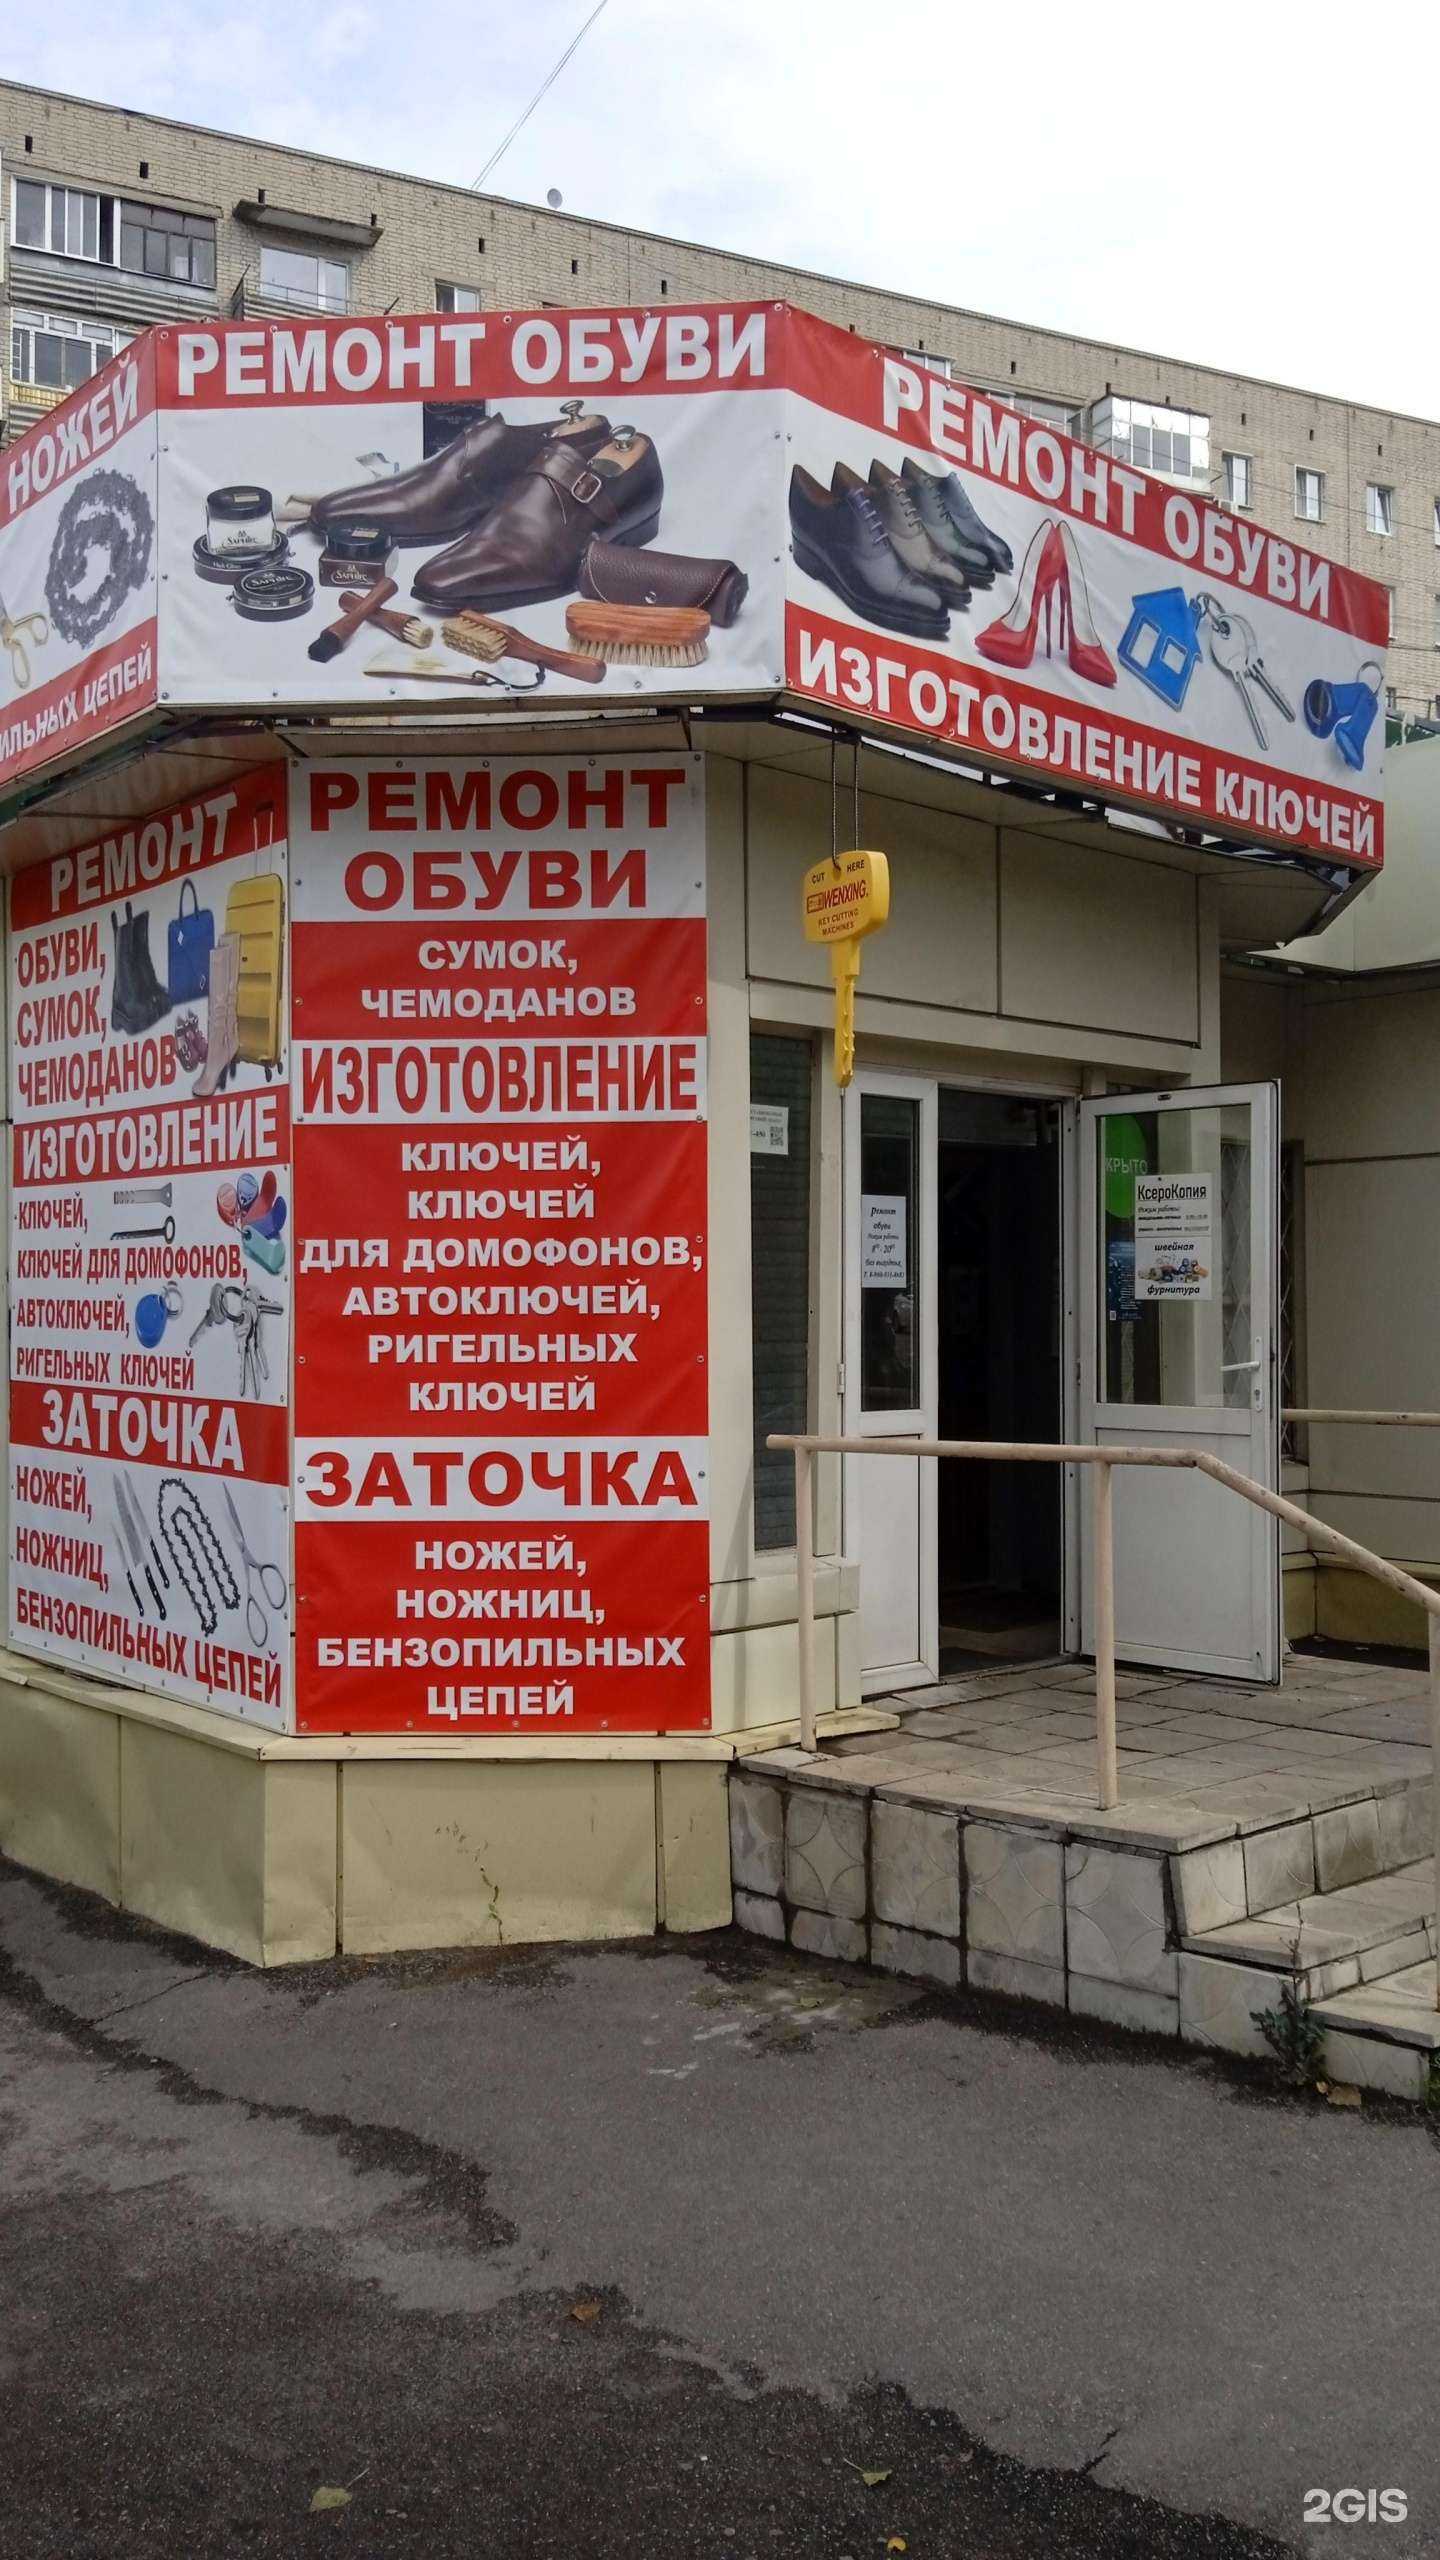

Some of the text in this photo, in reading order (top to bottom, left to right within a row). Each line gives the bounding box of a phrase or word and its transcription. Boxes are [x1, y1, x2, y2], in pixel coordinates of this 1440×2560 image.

[178, 313, 767, 397] РЕМОНТ ОБУВИ
[9, 351, 138, 515] НОЖЕЙ
[883, 356, 1334, 619] РЕМОНТ ОБУВИ
[83, 642, 152, 717] ЦЕПЕЙ
[800, 629, 1376, 857] ИЗГОТОВЛЕНИЕ КЛЮЧЕЙ
[309, 769, 686, 832] РЕМОНТ
[51, 792, 238, 912] РЕМОНТ
[812, 860, 865, 884] CUT HERE
[344, 849, 647, 913] ОБУВИ
[17, 921, 106, 989] ОБУВИ,
[418, 939, 579, 976] СУМОК,
[17, 984, 107, 1048] СУМОК,
[361, 986, 636, 1023] ЧЕМОДАНОВ
[18, 1033, 177, 1109] ЧЕМОДАНОВ
[302, 1043, 697, 1115] ИЗГОТОВЛЕНИЕ
[22, 1095, 278, 1181] ИЗГОТОВЛЕНИЕ
[401, 1134, 601, 1178] КЛЮЧЕЙ,
[18, 1192, 88, 1234] КЛЮЧЕЙ,
[407, 1182, 595, 1220] КЛЮЧЕЙ
[1138, 1184, 1207, 1203] КсероКопия
[17, 1243, 248, 1286] КЛЮЧЕЙ ДЛЯ ДОМОФОНОВ,
[299, 1236, 703, 1274] ДЛЯ ДОМОФОНОВ,
[1154, 1241, 1194, 1251] швейная
[341, 1278, 661, 1321] АВТОКЛЮЧЕЙ,
[1147, 1284, 1201, 1296] фурнитура
[16, 1293, 131, 1338] АВТОКЛЮЧЕЙ,
[16, 1346, 195, 1391] РИГЕЛЬНЫХ КЛЮЧЕЙ
[368, 1333, 638, 1364] РИГЕЛЬНЫХ
[409, 1375, 596, 1411] КЛЮЧЕЙ
[42, 1388, 244, 1472] ЗАТОЧКА
[16, 1464, 93, 1525] НОЖЕЙ,
[305, 1450, 698, 1508] ЗАТОЧКА
[16, 1525, 110, 1593] НОЖНИЦ,
[415, 1534, 587, 1578] НОЖЕЙ,
[396, 1588, 605, 1625] НОЖНИЦ,
[16, 1588, 282, 1708] БЕНЗОПИЛЬНЫХ ЦЕПЕЙ
[317, 1636, 686, 1668] БЕНЗОПИЛЬНЫХ
[427, 1679, 575, 1721] ЦЕПЕЙ
